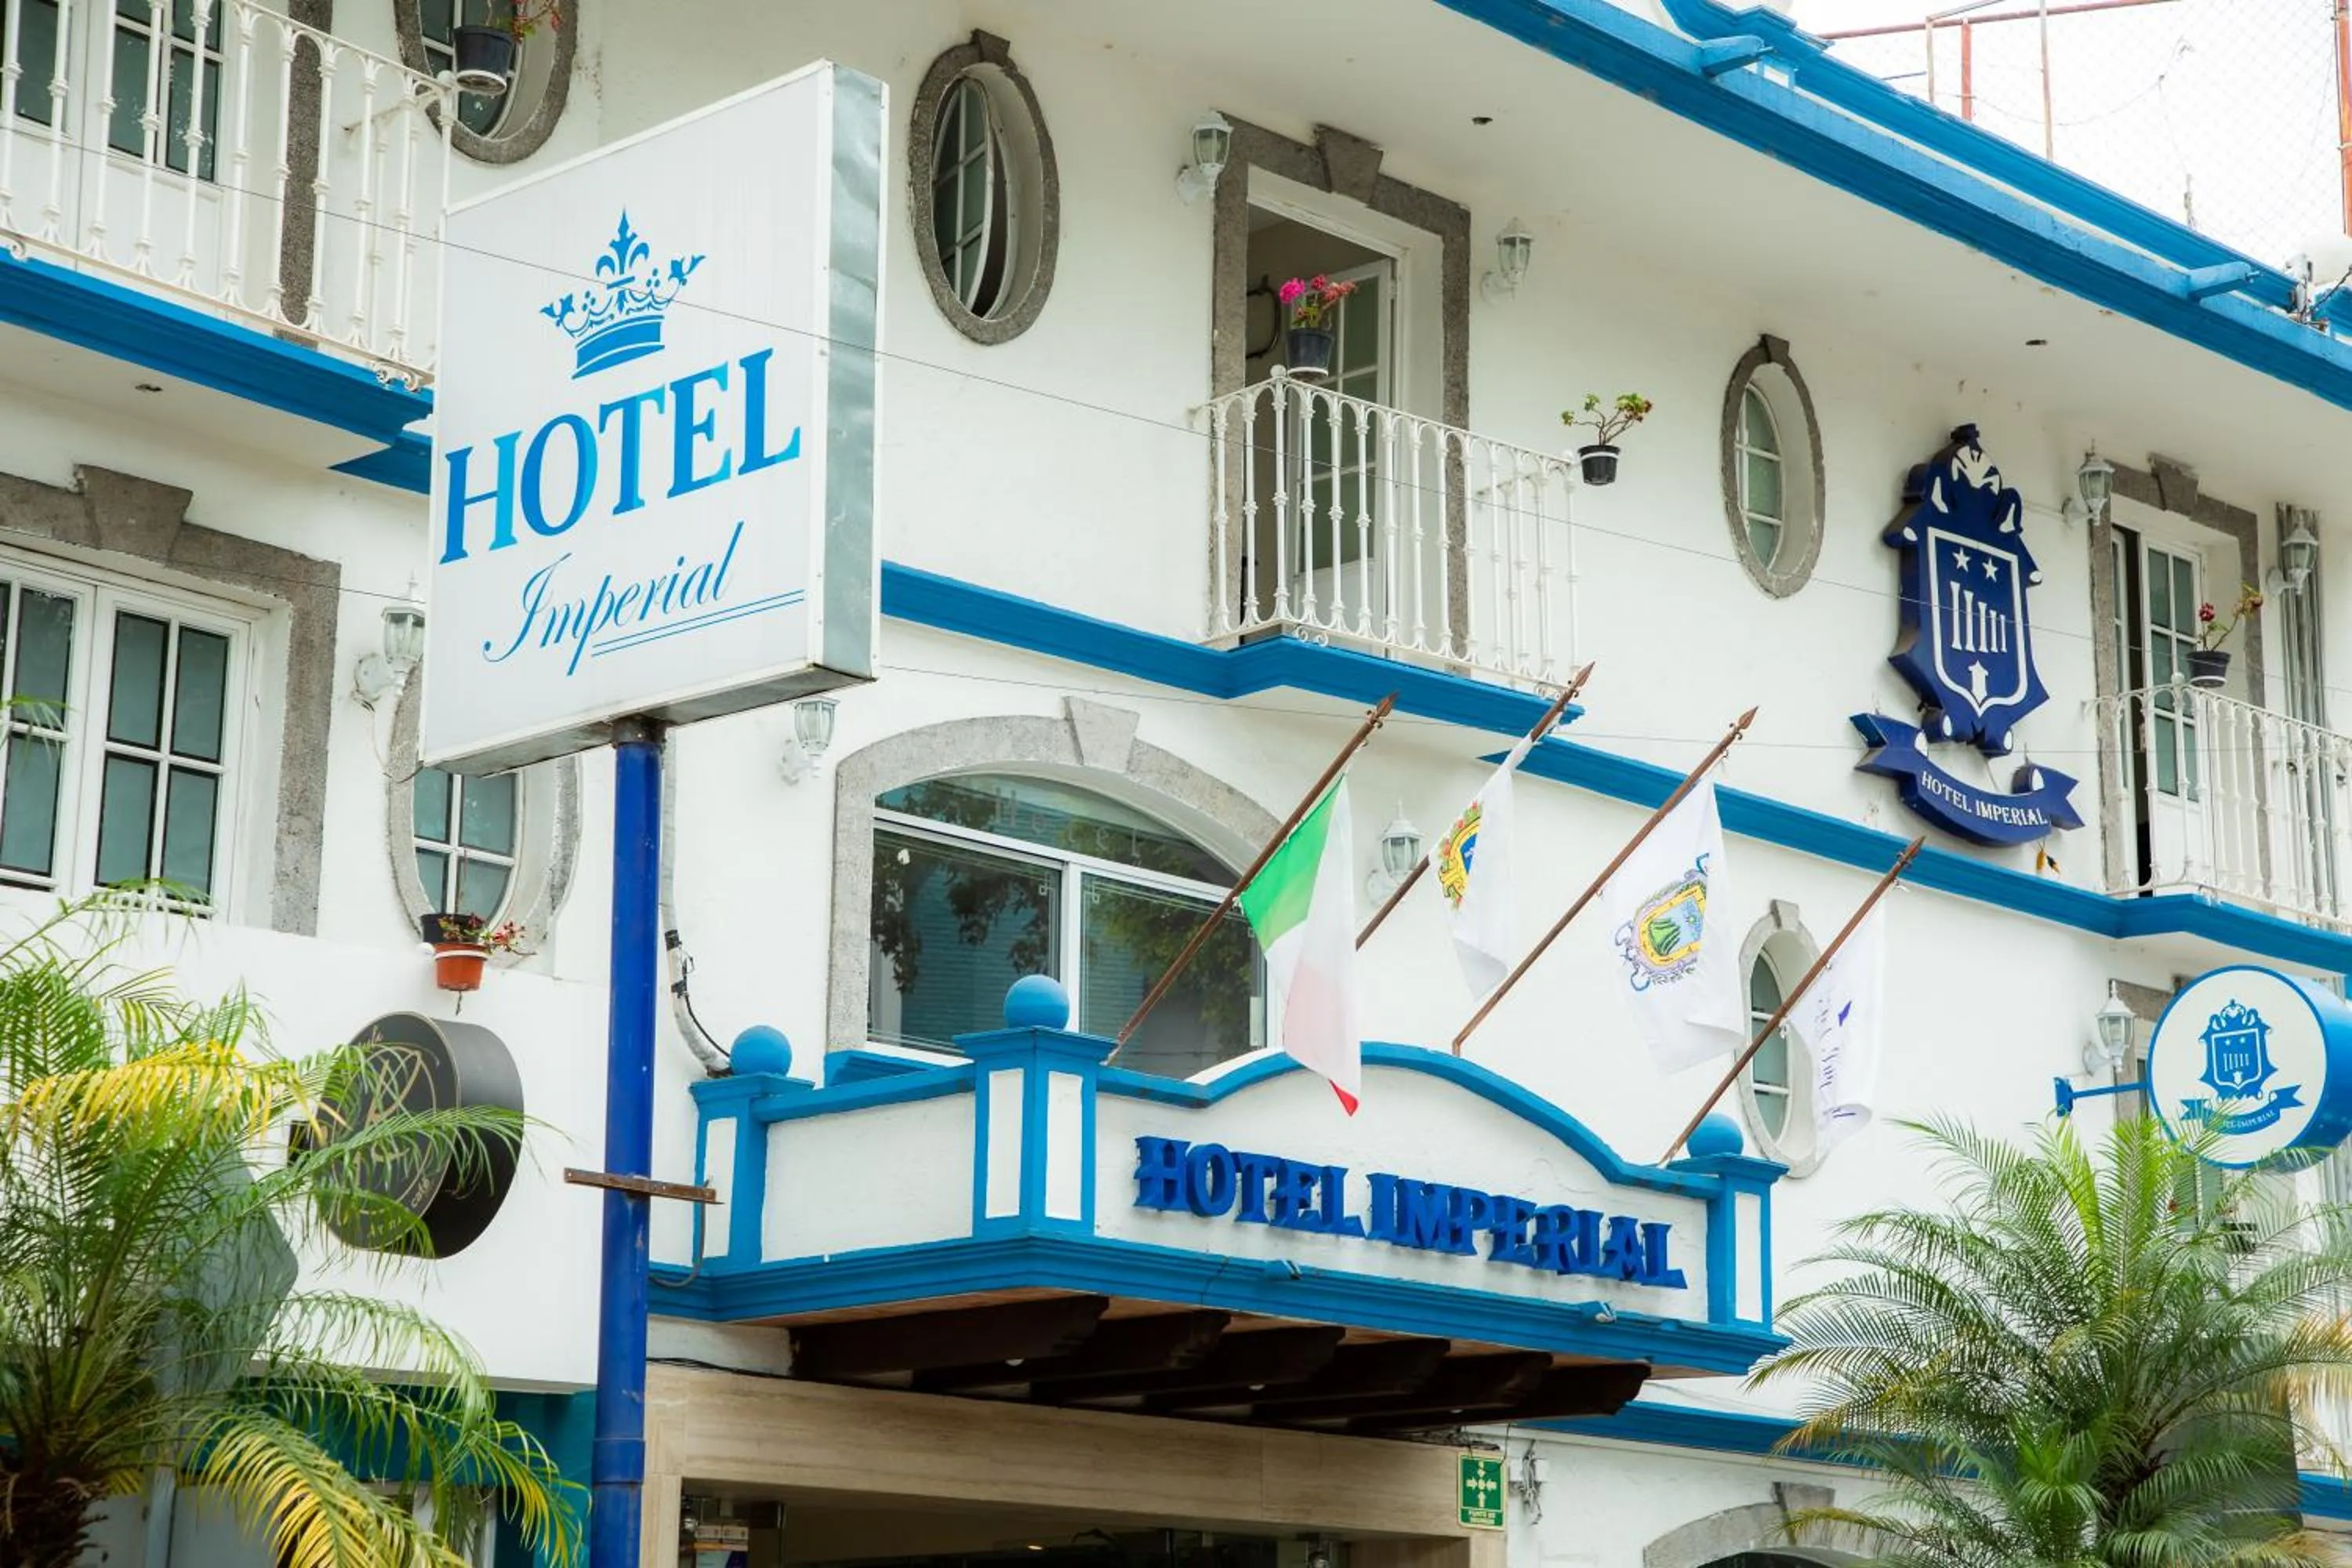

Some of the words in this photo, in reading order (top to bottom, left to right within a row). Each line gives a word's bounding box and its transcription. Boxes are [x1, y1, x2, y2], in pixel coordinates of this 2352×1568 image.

[439, 348, 801, 564] HOTEL
[483, 521, 745, 676] Imperial
[1922, 771, 1972, 813] HOTEL
[1976, 800, 2049, 826] IMPERIAL
[1134, 1135, 1364, 1236] HOTEL
[1367, 1173, 1687, 1289] IMPERIAL
